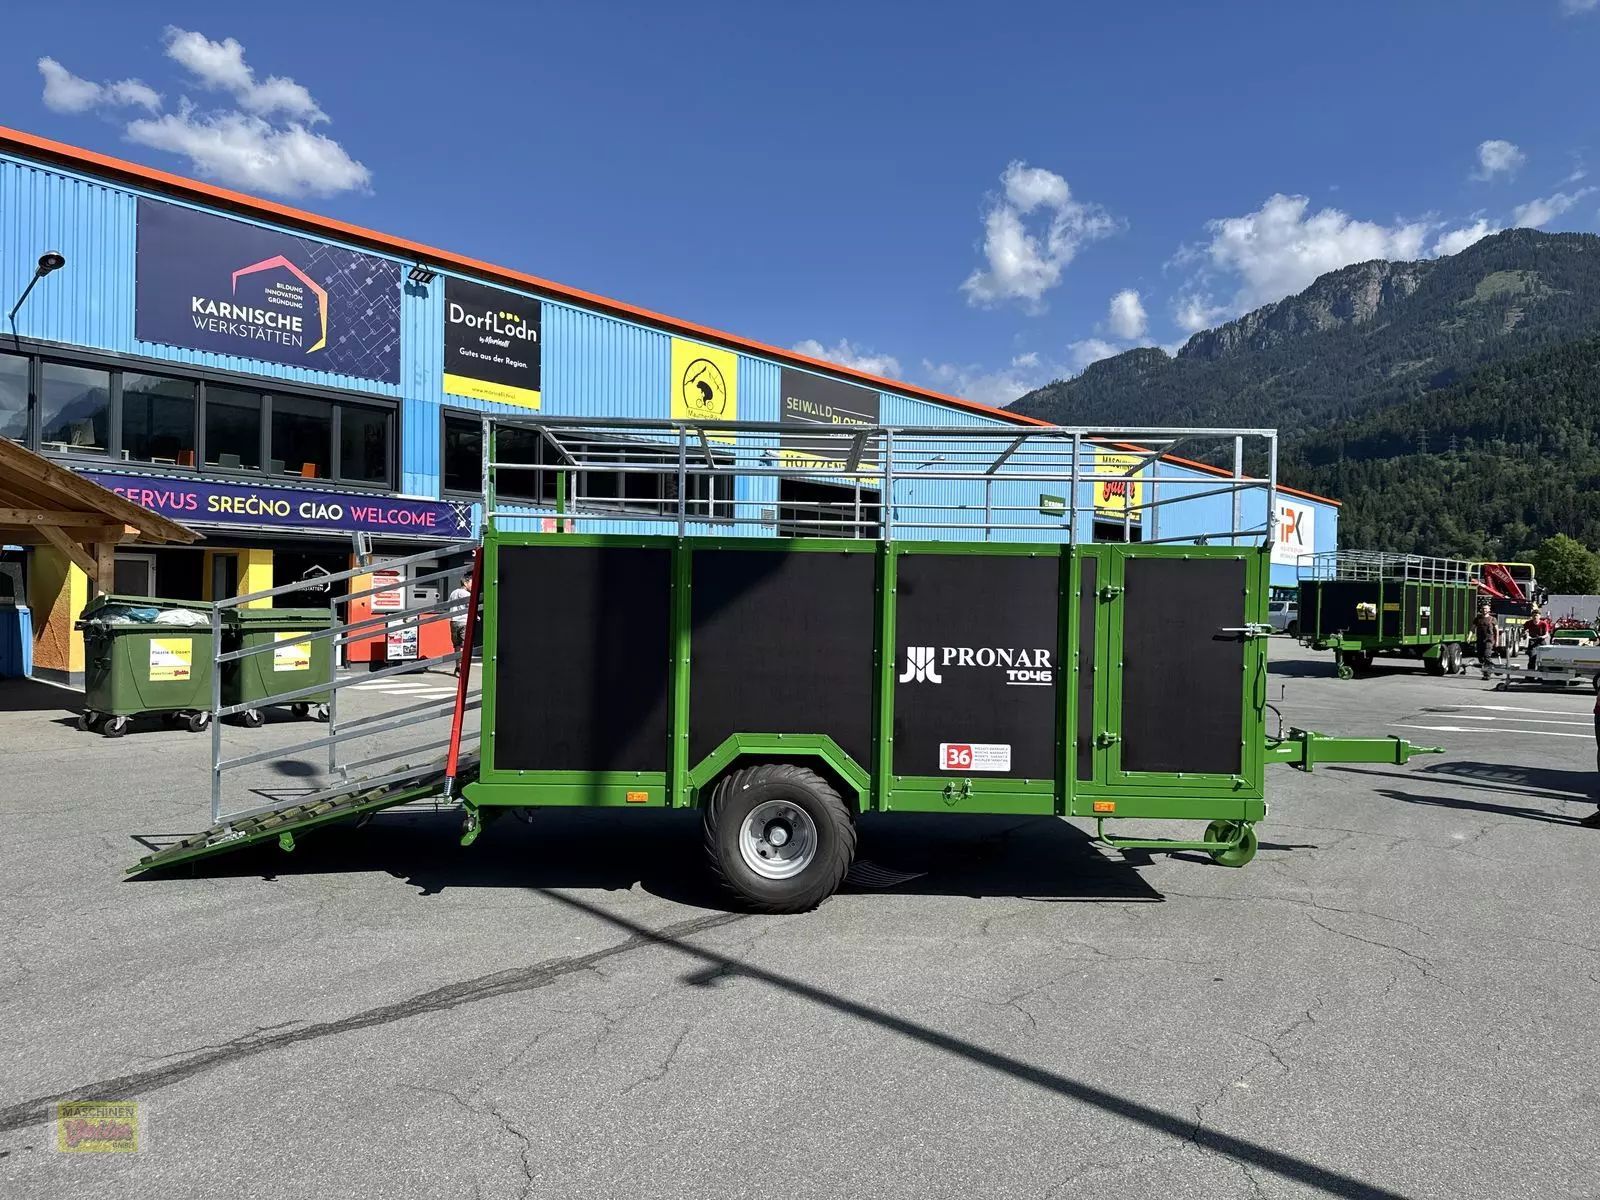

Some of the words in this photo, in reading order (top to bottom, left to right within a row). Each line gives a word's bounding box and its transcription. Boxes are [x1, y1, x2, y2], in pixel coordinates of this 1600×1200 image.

[264, 288, 303, 301] INNOVATION
[276, 282, 303, 294] BILDUNG
[267, 295, 303, 309] GRÜNDUNG
[192, 296, 303, 333] KARNISCHE
[449, 302, 537, 342] DorfLodn
[192, 315, 303, 348] WERKSTÄTTEN
[459, 347, 479, 358] Gutes
[480, 353, 492, 361] aus
[493, 355, 504, 363] der
[786, 396, 833, 418] SEIWALD
[207, 494, 291, 517] SREČNO
[298, 502, 343, 521] CIAO
[350, 506, 436, 528] WELCOME
[941, 647, 1052, 668] PRONAR
[948, 748, 970, 766] 36
